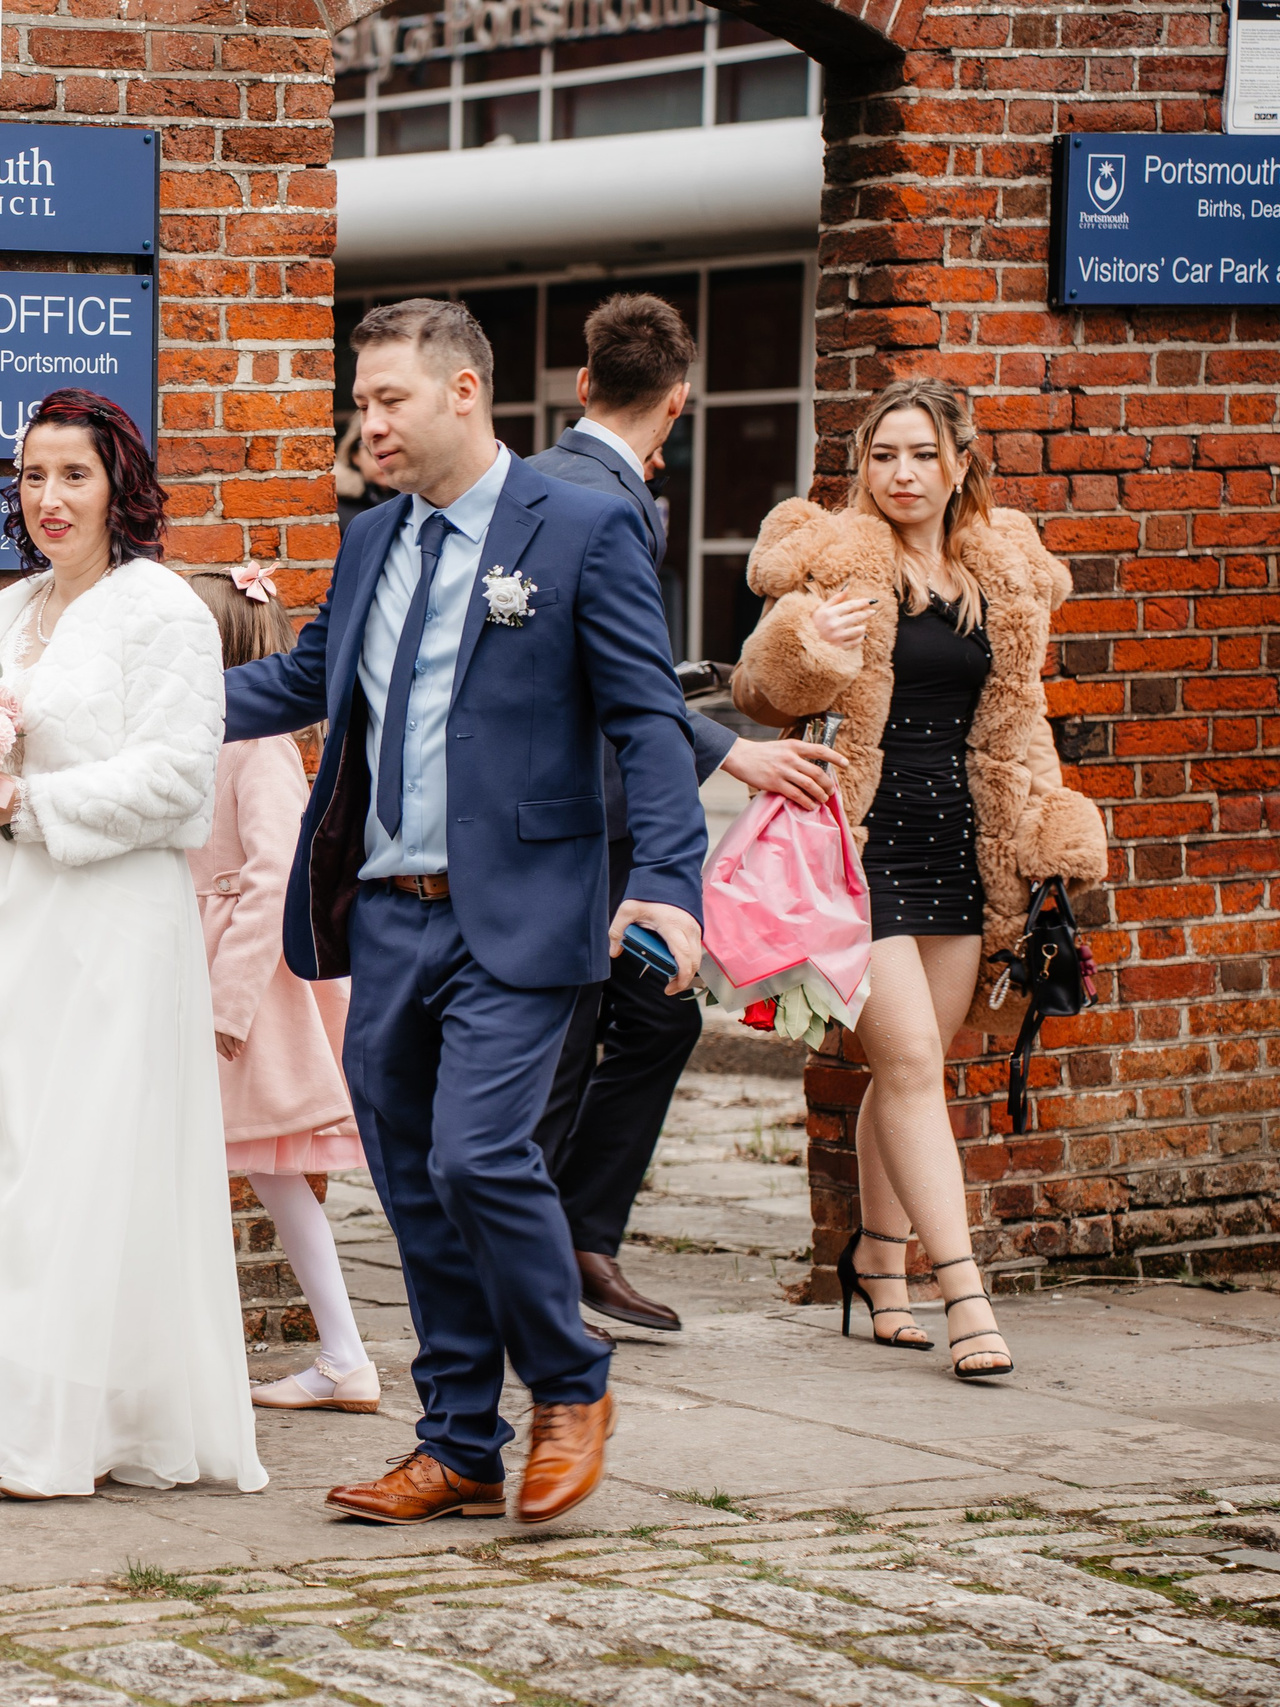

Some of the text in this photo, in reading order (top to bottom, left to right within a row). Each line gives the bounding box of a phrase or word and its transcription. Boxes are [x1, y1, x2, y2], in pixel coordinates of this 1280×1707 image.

[1145, 156, 1280, 185] Portsmouth
[1079, 211, 1129, 223] Portsmouth
[1198, 199, 1245, 219] Births,
[1098, 222, 1129, 230] COUNCIL
[1079, 257, 1164, 282] Visitors’
[1173, 257, 1213, 283] Car
[1220, 258, 1269, 283] Park
[1, 350, 117, 374] Portsmouth
